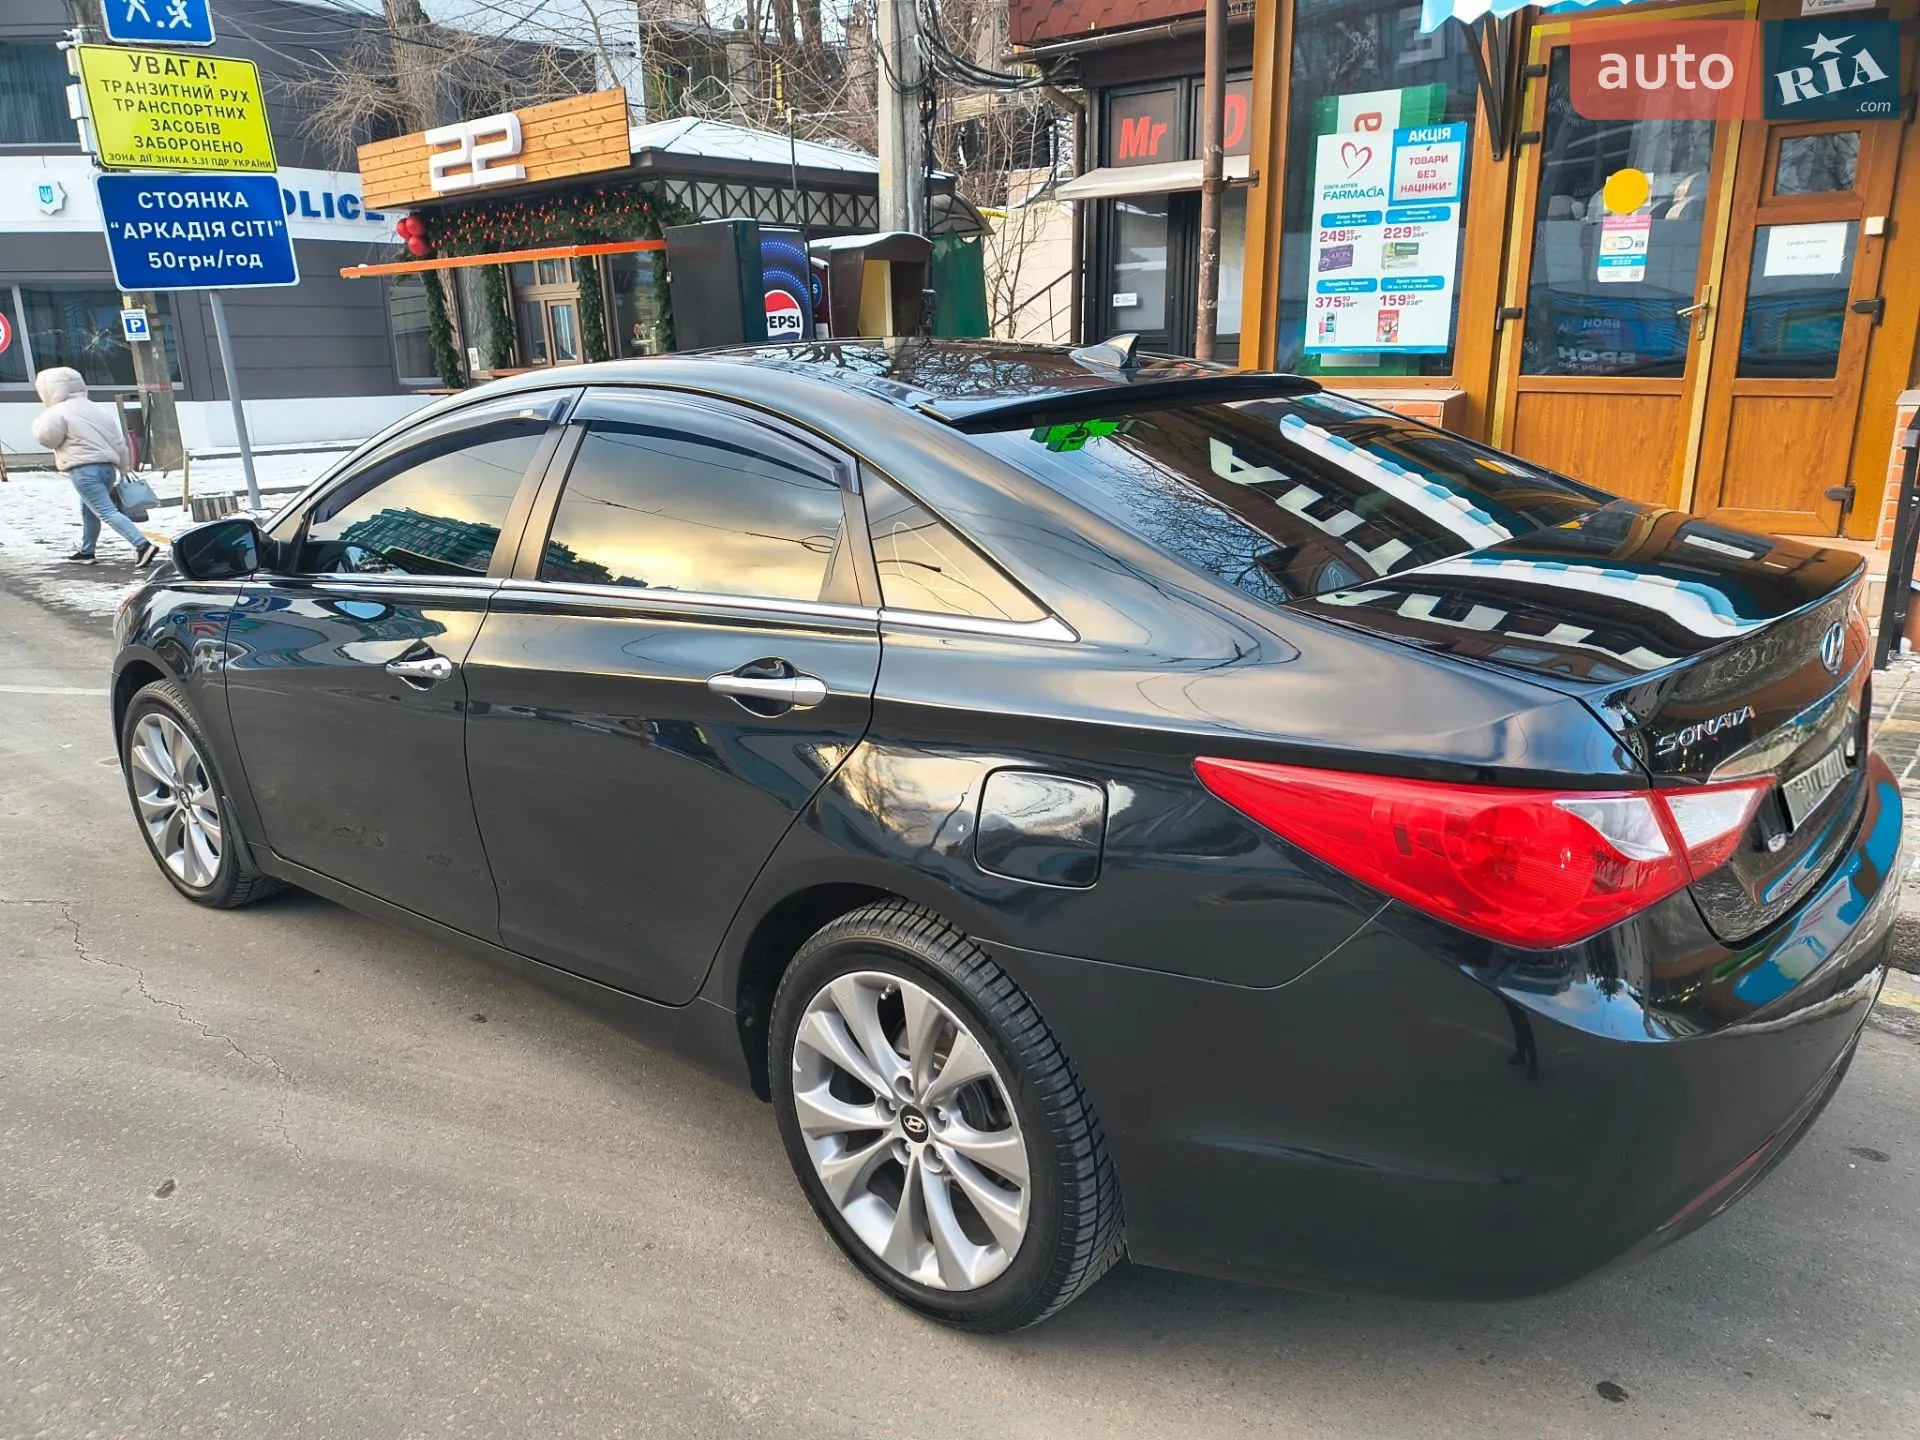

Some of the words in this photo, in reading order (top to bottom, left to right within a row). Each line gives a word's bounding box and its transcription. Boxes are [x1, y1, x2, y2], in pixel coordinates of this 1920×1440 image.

[128, 54, 217, 80] УВАГА!
[100, 79, 214, 101] ТРАНЗИТНИЙ
[219, 88, 250, 104] РУХ
[113, 98, 247, 120] ТРАНСПОРТНИХ
[150, 118, 221, 135] ЗАСОБІВ
[1408, 127, 1451, 143] АКЦІЯ
[133, 135, 243, 154] ЗАБОРОНЕНО
[1119, 115, 1168, 160] Mr
[424, 112, 527, 192] 22
[1408, 154, 1449, 166] ТОВАРИ
[108, 153, 136, 163] ЗОНА
[140, 153, 153, 163] ДІЇ
[156, 154, 189, 165] ЗНАКА
[191, 156, 209, 166] 5.31
[211, 158, 230, 168] ПДР
[233, 157, 272, 169] УКРАЇНИ
[1417, 169, 1437, 179] БЕЗ
[137, 191, 250, 209] СТОЯНКА
[1319, 230, 1346, 243] 249
[1383, 226, 1411, 239] 229
[148, 249, 264, 272] 50грн/год
[1315, 296, 1342, 308] 375
[1380, 294, 1407, 306] 159
[767, 314, 801, 329] EPSI
[1654, 705, 1756, 757] SONATA
